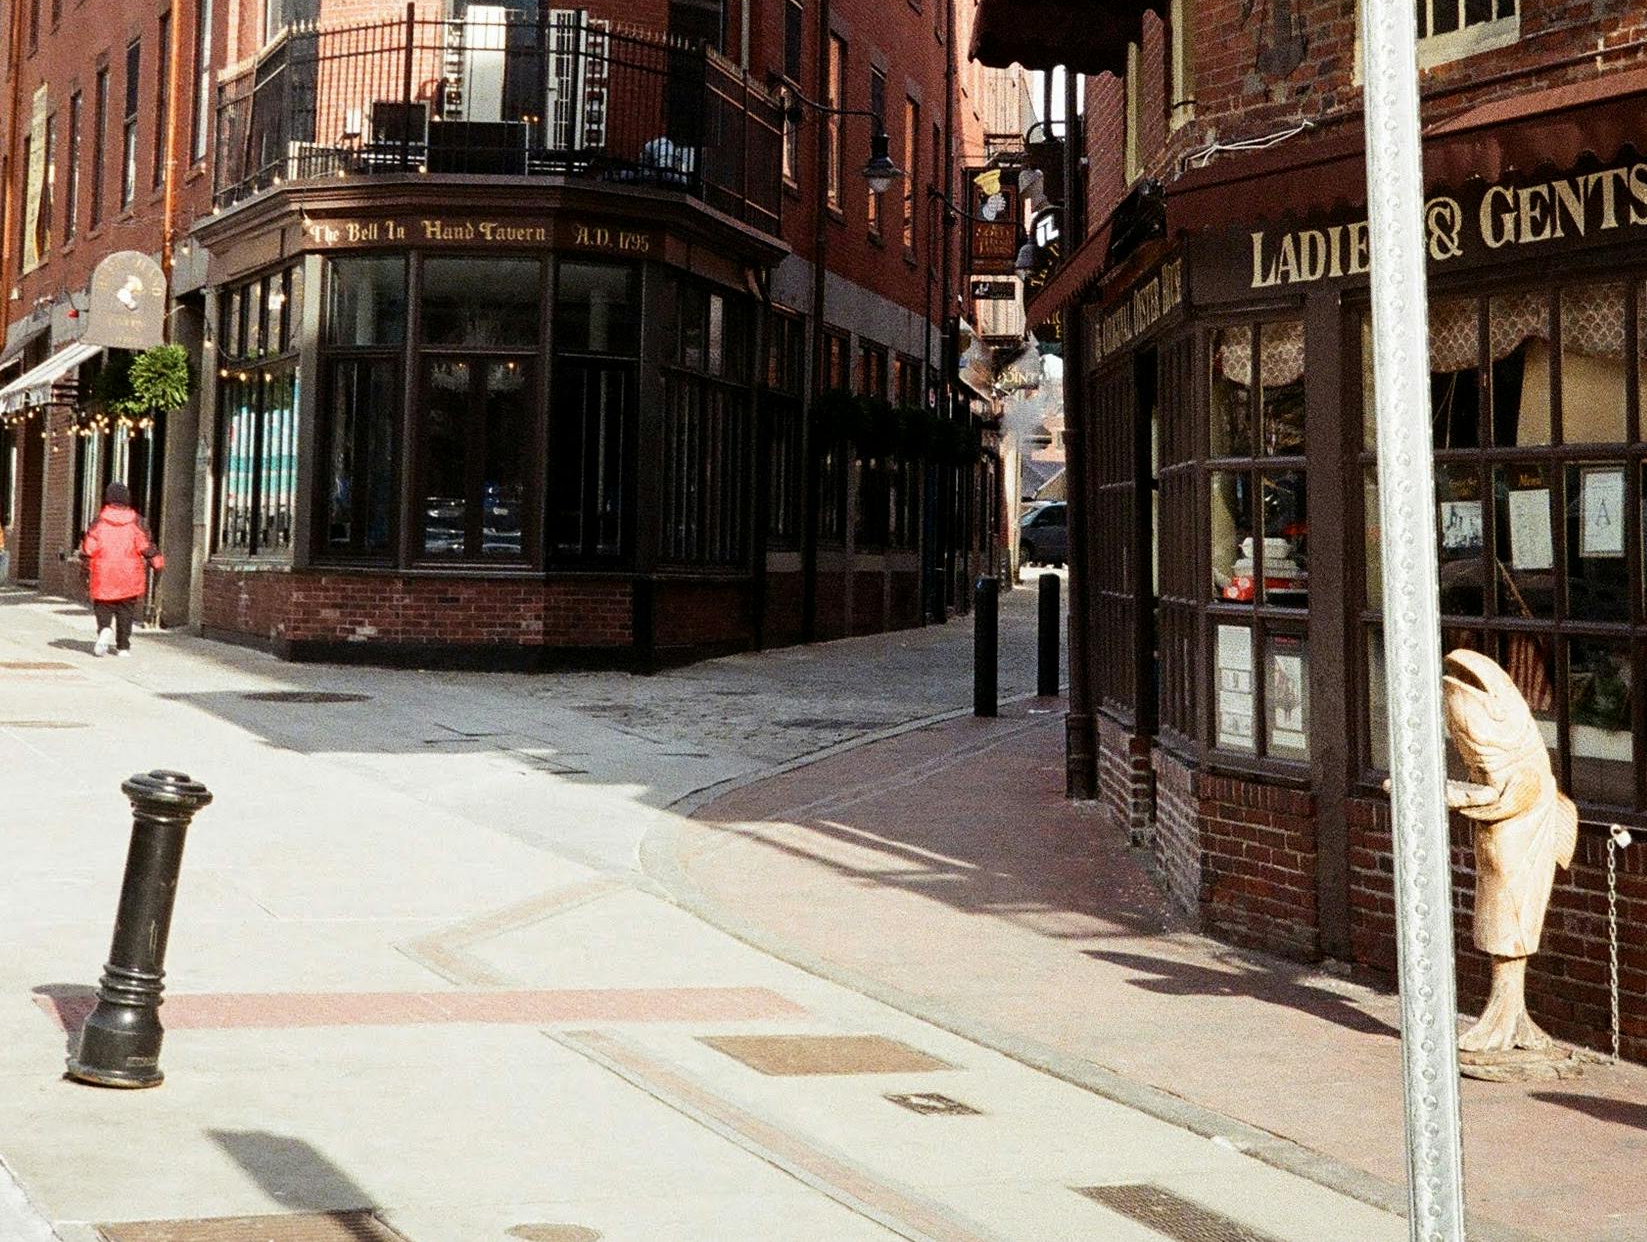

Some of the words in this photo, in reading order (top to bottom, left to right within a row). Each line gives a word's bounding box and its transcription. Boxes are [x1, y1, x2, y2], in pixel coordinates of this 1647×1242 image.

[309, 224, 341, 246] The
[346, 222, 378, 242] Bell
[385, 220, 406, 240] In
[421, 219, 475, 240] Hand
[479, 221, 546, 241] Tavern
[619, 231, 650, 253] 1795
[1250, 220, 1371, 289] LADIE
[1426, 196, 1464, 260] &
[1479, 162, 1647, 250] GENTS
